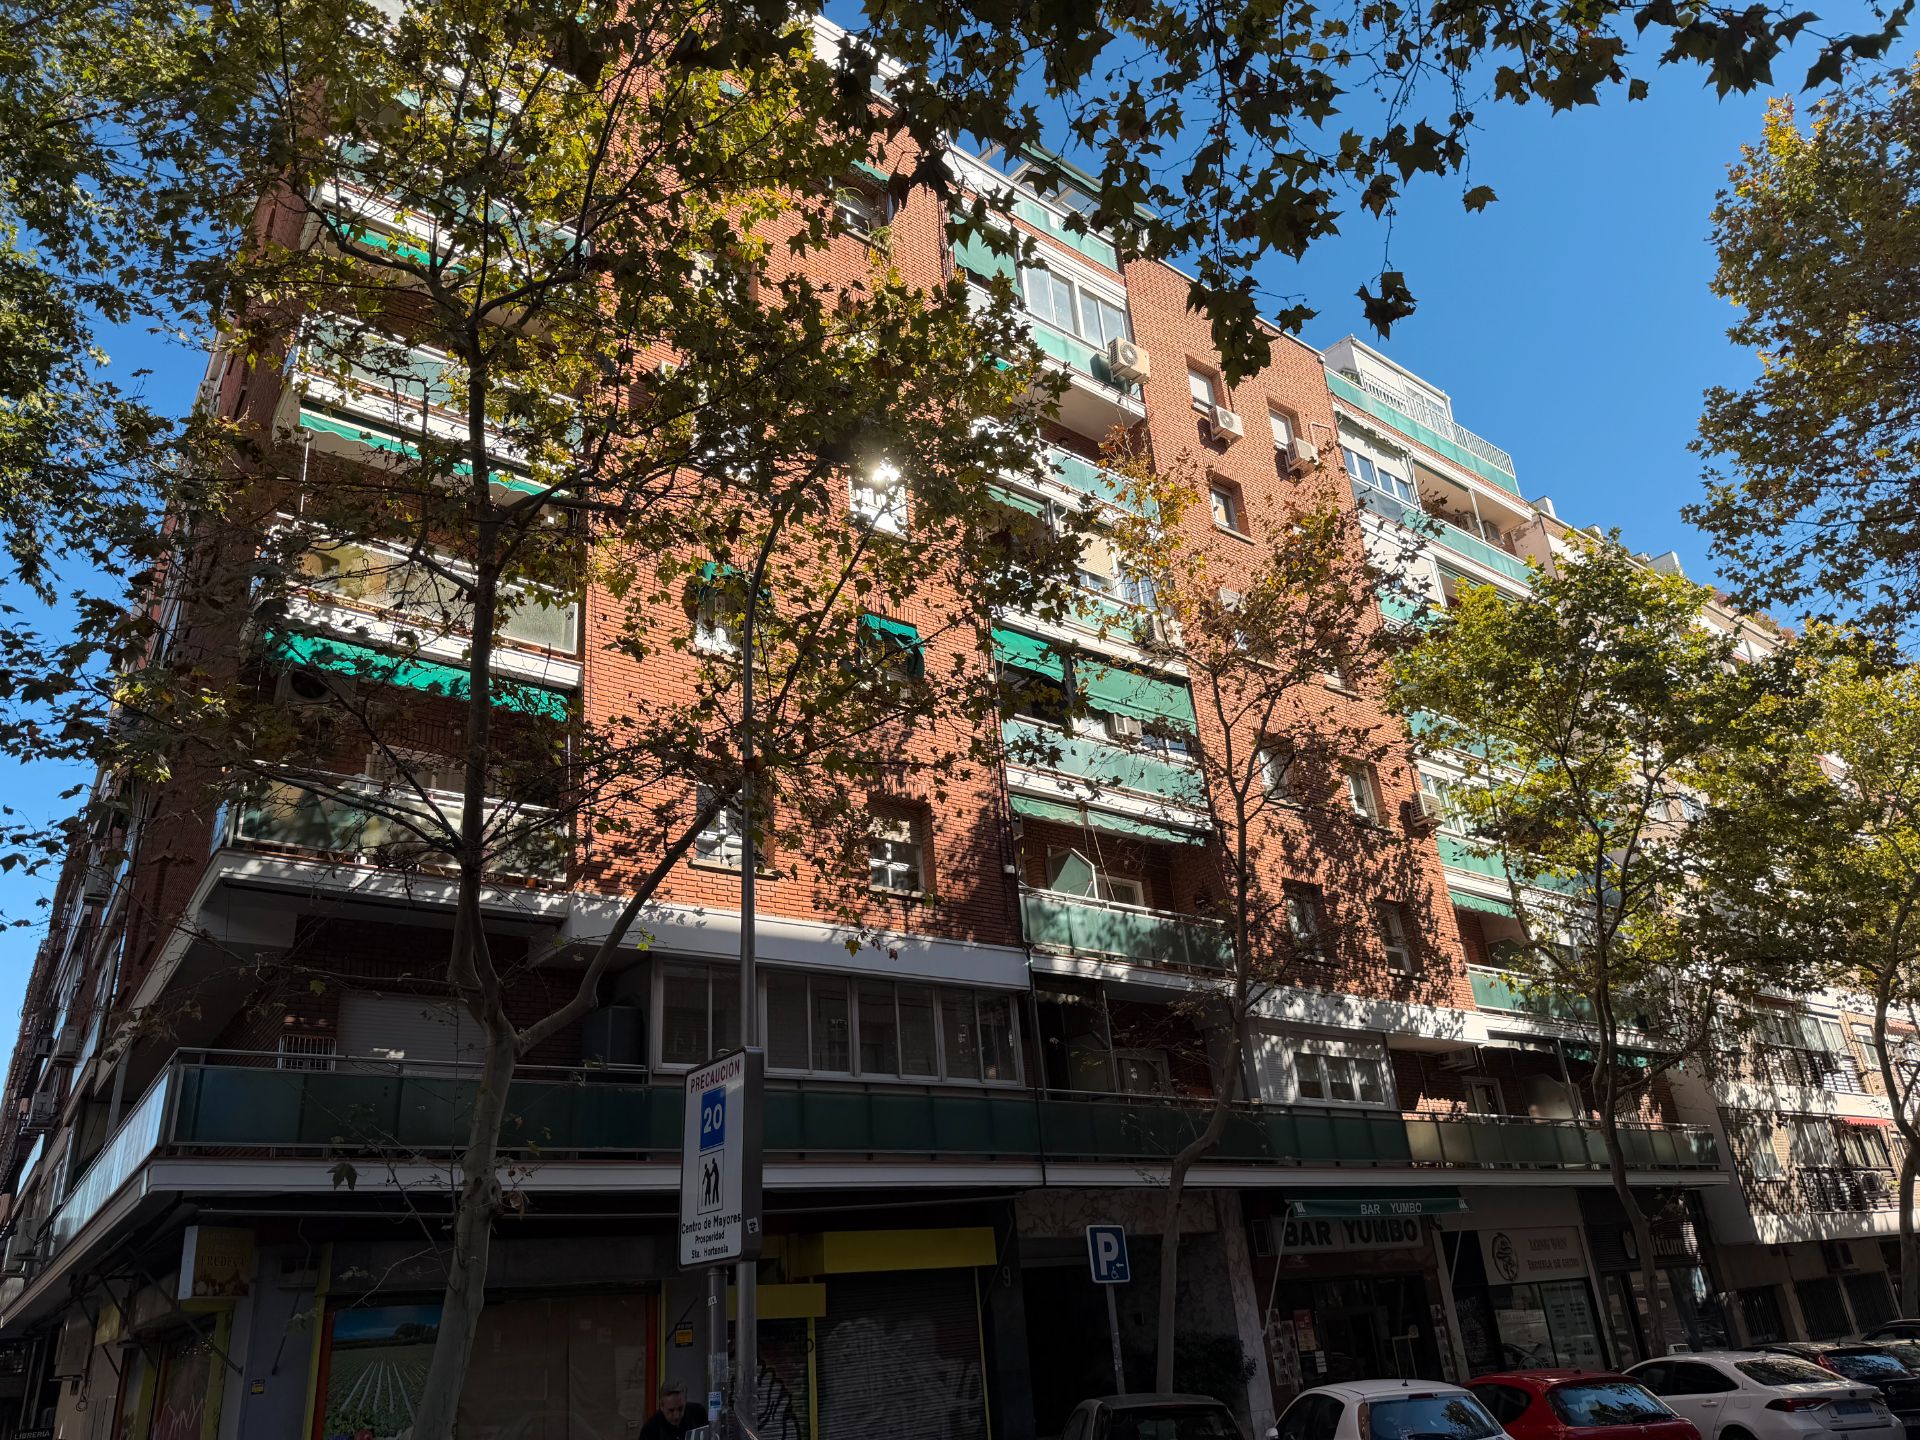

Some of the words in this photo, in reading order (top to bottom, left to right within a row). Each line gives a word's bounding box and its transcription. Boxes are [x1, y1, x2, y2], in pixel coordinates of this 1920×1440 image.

[690, 1059, 740, 1093] PRECAUCIÓN
[704, 1104, 722, 1133] 20
[1361, 1204, 1380, 1214] BAR
[1390, 1202, 1422, 1213] YUMBO
[682, 1221, 702, 1234] Centro
[703, 1217, 712, 1229] de
[713, 1213, 741, 1228] Mayores
[1282, 1221, 1333, 1247] BAR
[1342, 1219, 1418, 1244] YUMBO
[695, 1230, 725, 1244] Prosperidad
[703, 1244, 729, 1257] Hortensia
[1096, 1232, 1119, 1275] P
[1002, 1265, 1011, 1288] 9
